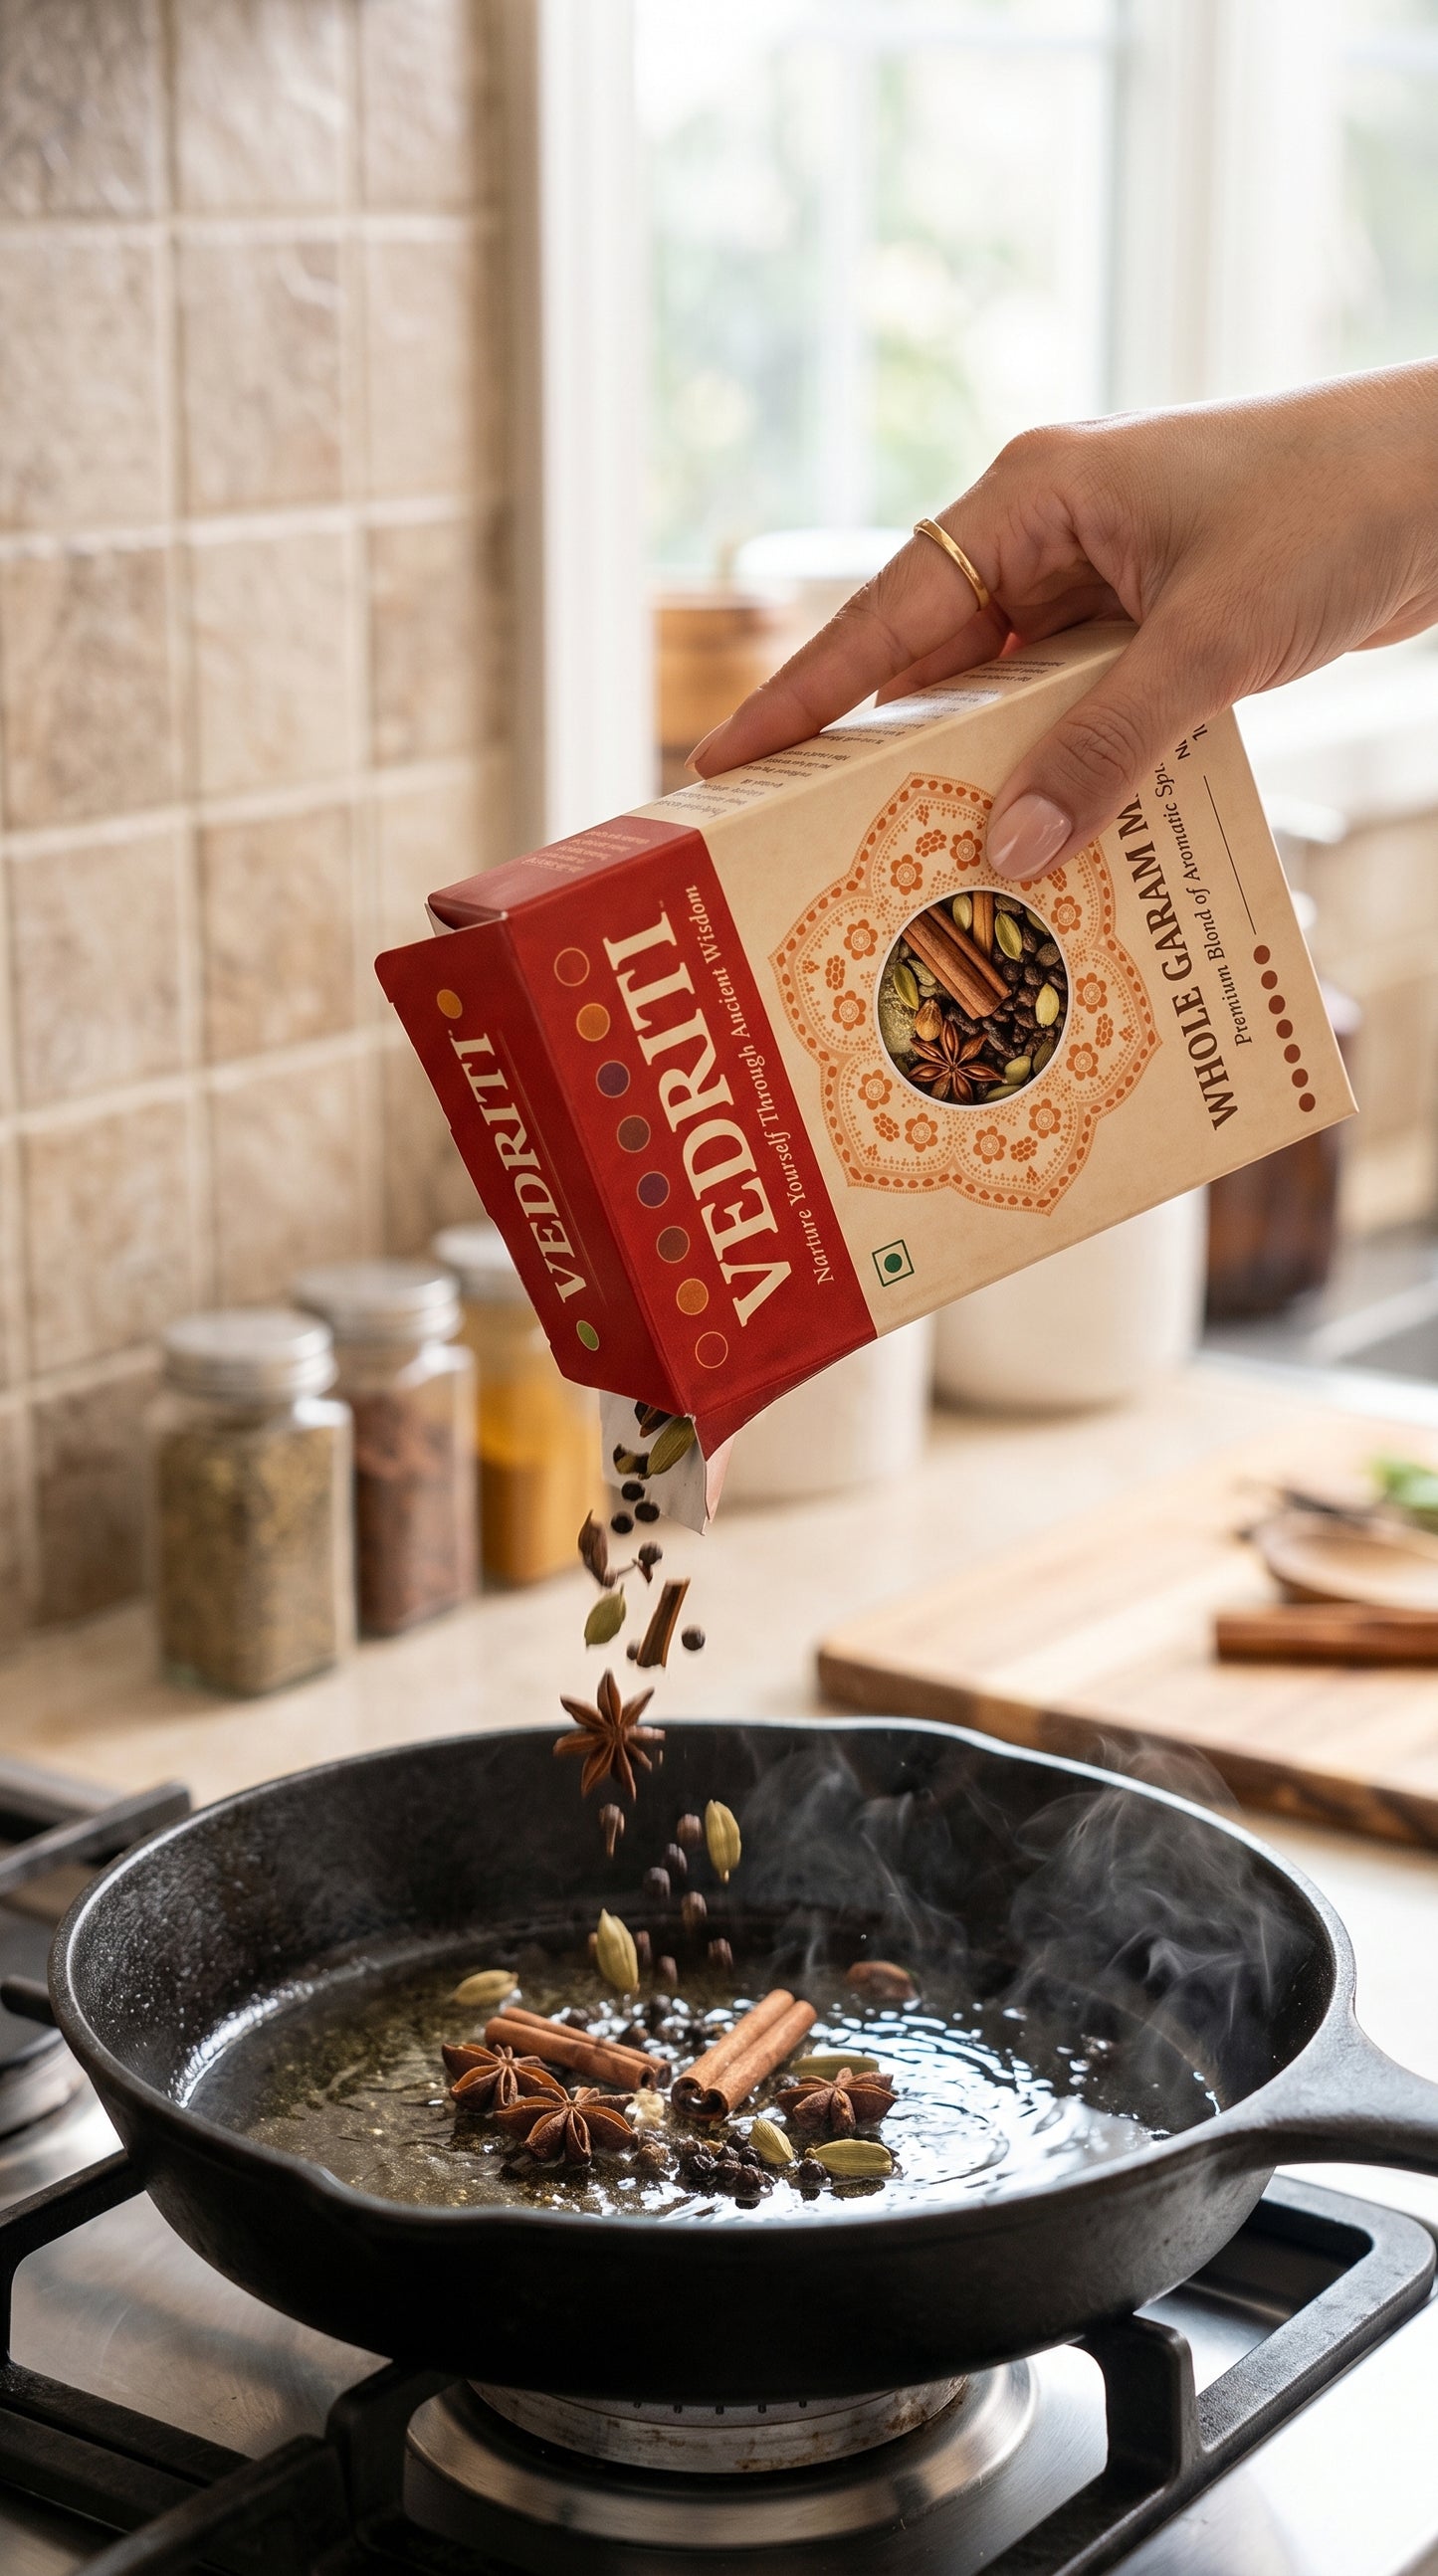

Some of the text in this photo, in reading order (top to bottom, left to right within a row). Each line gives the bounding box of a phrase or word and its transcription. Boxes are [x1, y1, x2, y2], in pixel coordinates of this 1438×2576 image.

[1162, 802, 1201, 882] Aromatic
[685, 885, 722, 964] Wisdom
[1125, 840, 1193, 982] GARAM
[1185, 887, 1211, 905] of
[712, 966, 751, 1039] Ancient
[1217, 964, 1253, 1047] Premium
[737, 1044, 780, 1128] Through
[1171, 985, 1239, 1131] WHOLE
[602, 910, 793, 1328] VEDRITI
[449, 1031, 588, 1303] VEDRITI
[763, 1130, 807, 1207] Yourself
